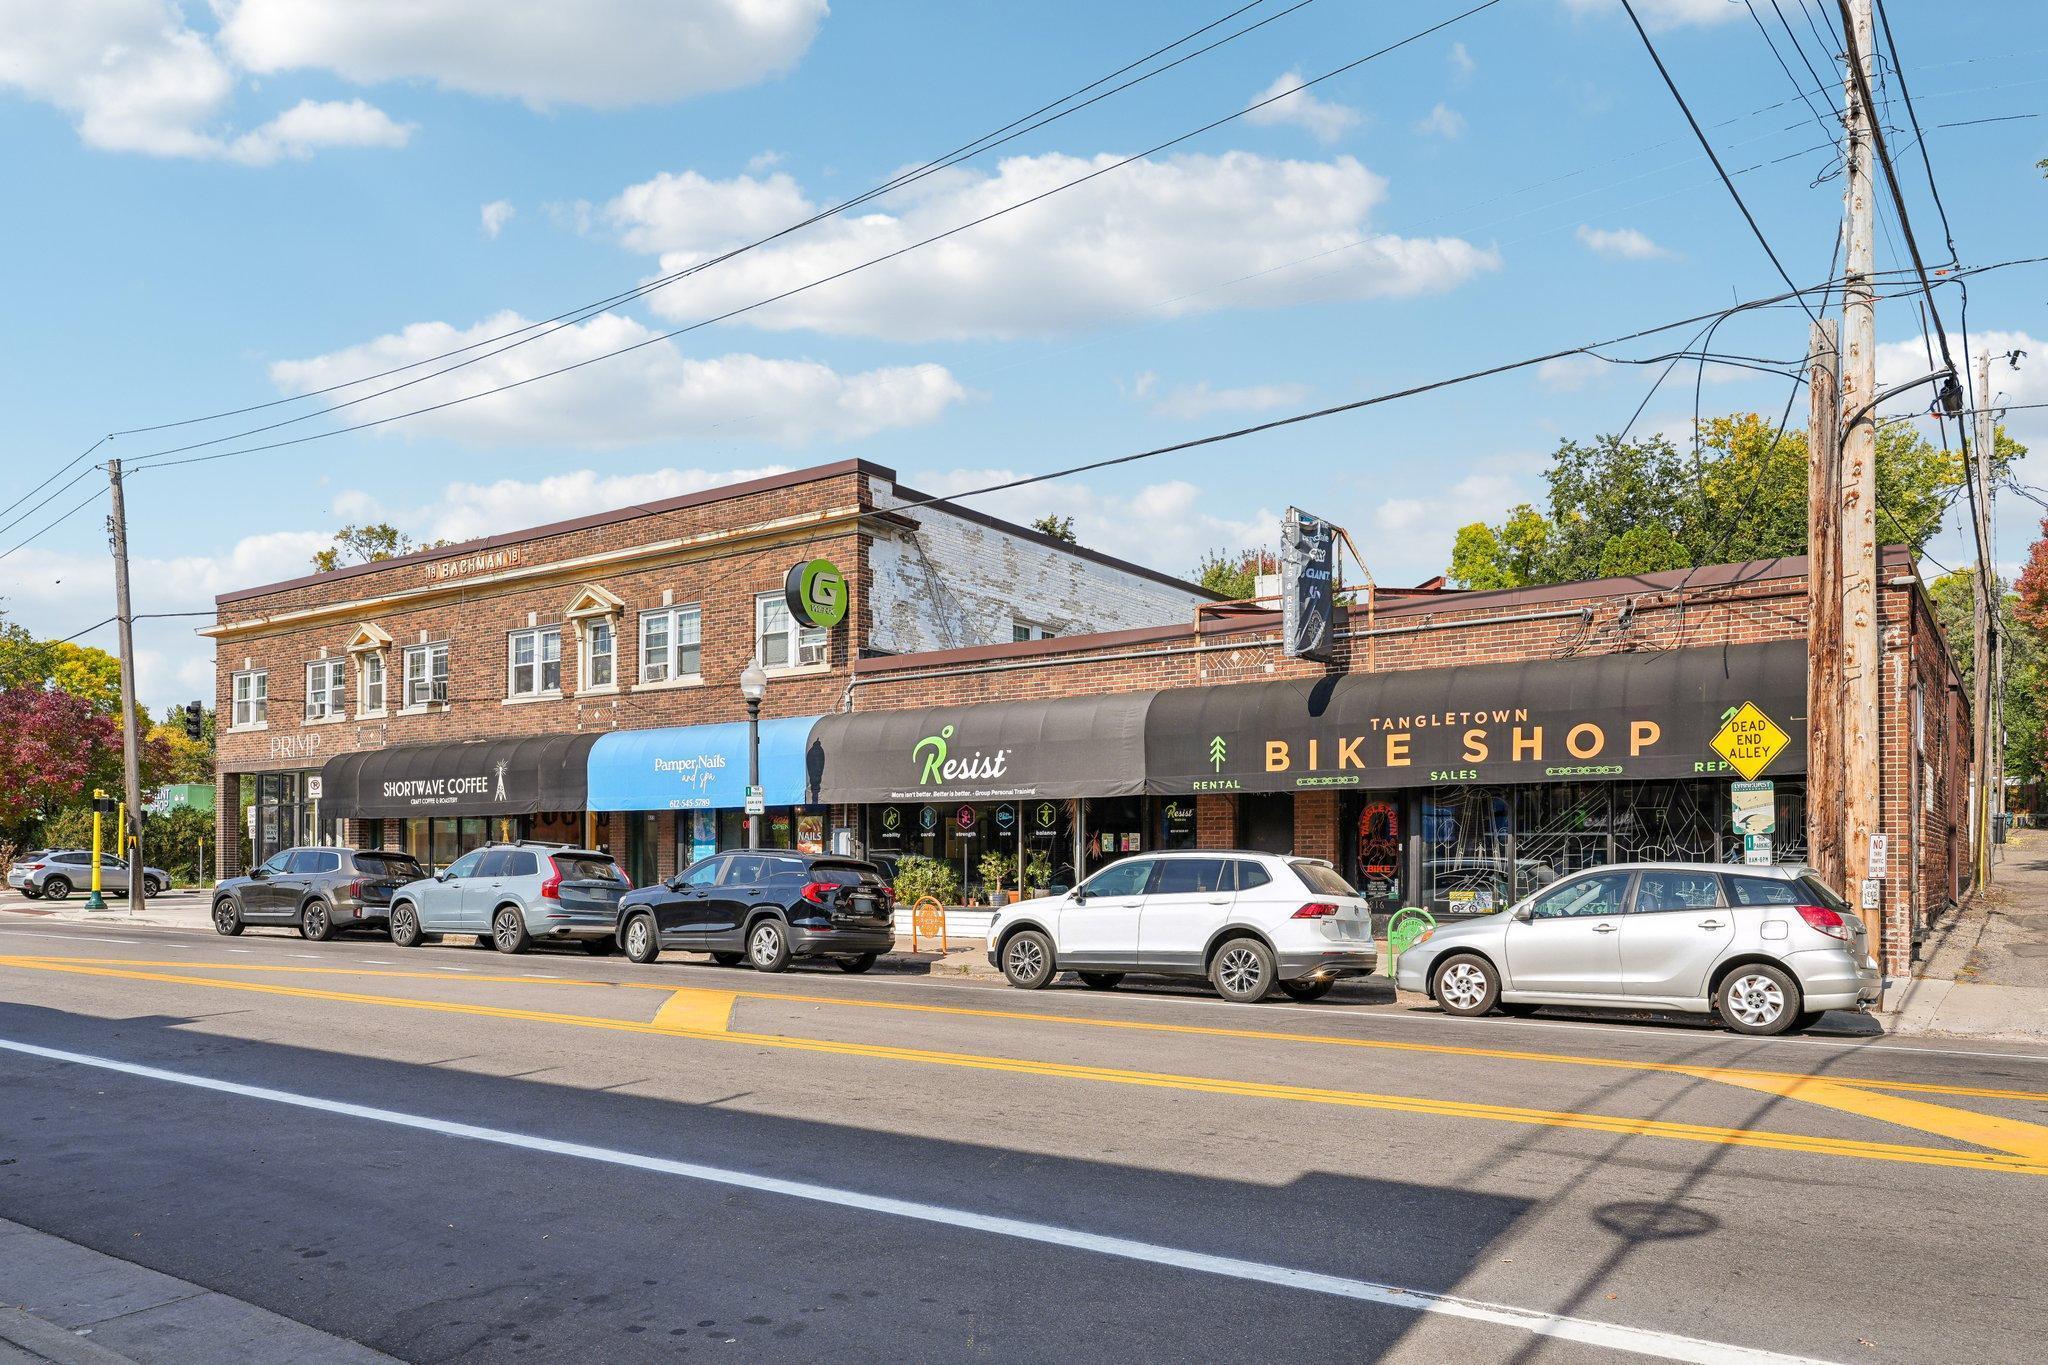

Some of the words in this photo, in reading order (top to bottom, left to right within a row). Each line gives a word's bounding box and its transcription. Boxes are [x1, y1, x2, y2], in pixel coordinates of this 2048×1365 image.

[442, 551, 504, 577] BACHMAN
[809, 572, 839, 606] G
[1287, 582, 1293, 590] &
[1286, 595, 1294, 653] REPAIRS
[1371, 708, 1528, 731] TANGLETOWN
[1731, 720, 1766, 733] DEAD
[271, 733, 320, 759] PRIMP
[1265, 733, 1411, 772] BIKE
[1462, 721, 1661, 763] SHOP
[1737, 734, 1761, 745] END
[912, 724, 1007, 785] Resist
[1729, 746, 1770, 759] ALLEY
[654, 758, 696, 773] Pamper
[698, 753, 726, 769] Nails
[1694, 761, 1734, 772] REP
[1430, 770, 1477, 781] SALES
[383, 779, 445, 797] SHORTWAVE
[447, 776, 488, 794] COFFEE
[1193, 779, 1241, 790] RENTAL
[1360, 802, 1398, 837] TANGLETOWN
[799, 832, 822, 840] NAILS
[1873, 840, 1884, 849] NO
[1367, 864, 1391, 873] BIKE
